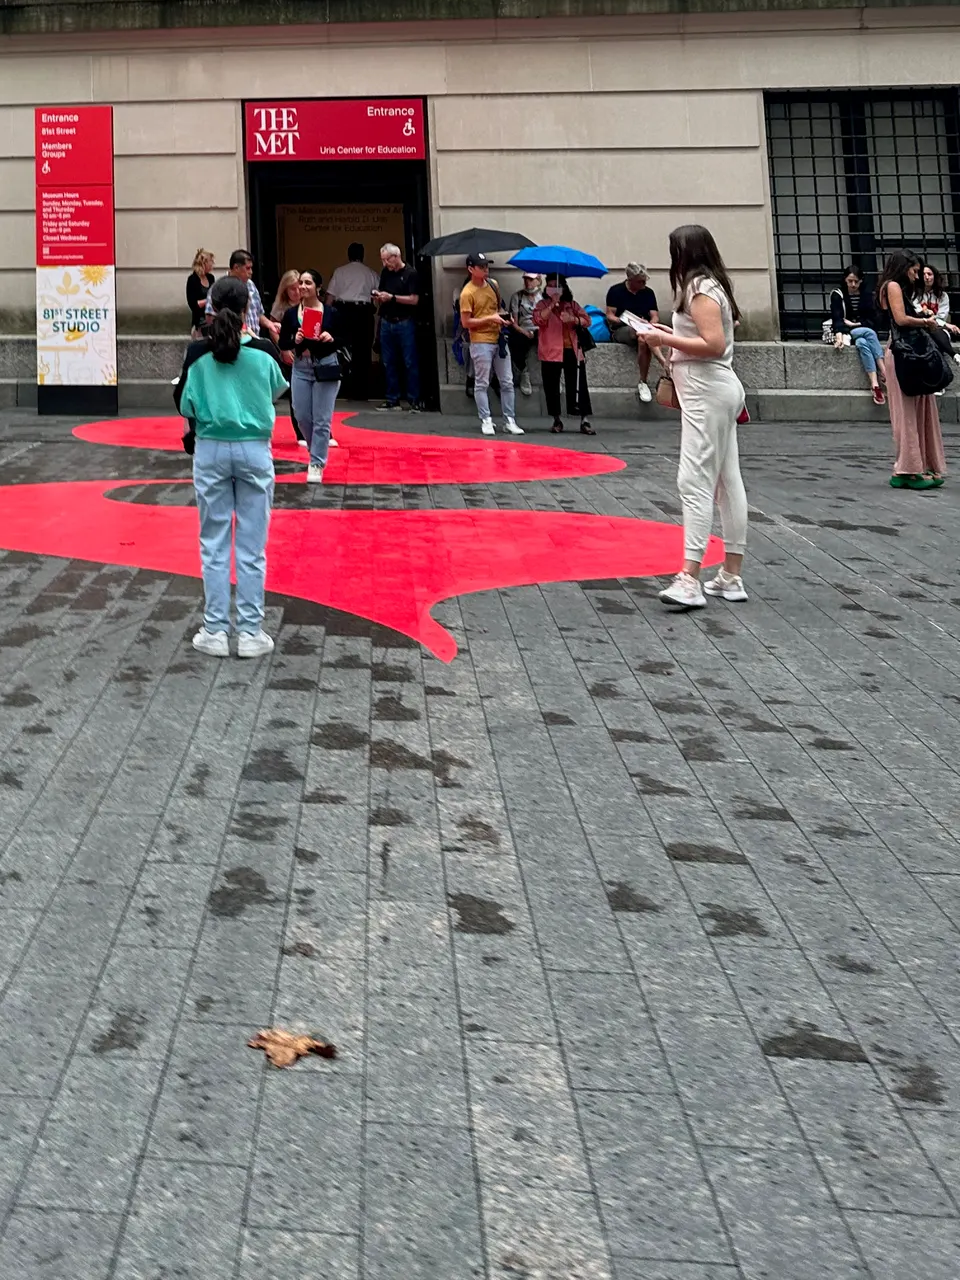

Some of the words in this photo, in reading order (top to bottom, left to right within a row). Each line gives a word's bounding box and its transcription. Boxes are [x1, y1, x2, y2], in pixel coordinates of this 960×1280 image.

[367, 106, 415, 117] Entrance
[42, 113, 79, 123] Entrance
[253, 107, 299, 131] THE
[56, 127, 76, 135] Street
[42, 142, 72, 150] Members
[253, 131, 300, 156] MET
[320, 146, 336, 155] Uris
[337, 146, 364, 154] Center
[365, 145, 376, 154] for
[377, 145, 417, 154] Education
[65, 308, 109, 320] STREET
[52, 321, 100, 333] STUDIO
